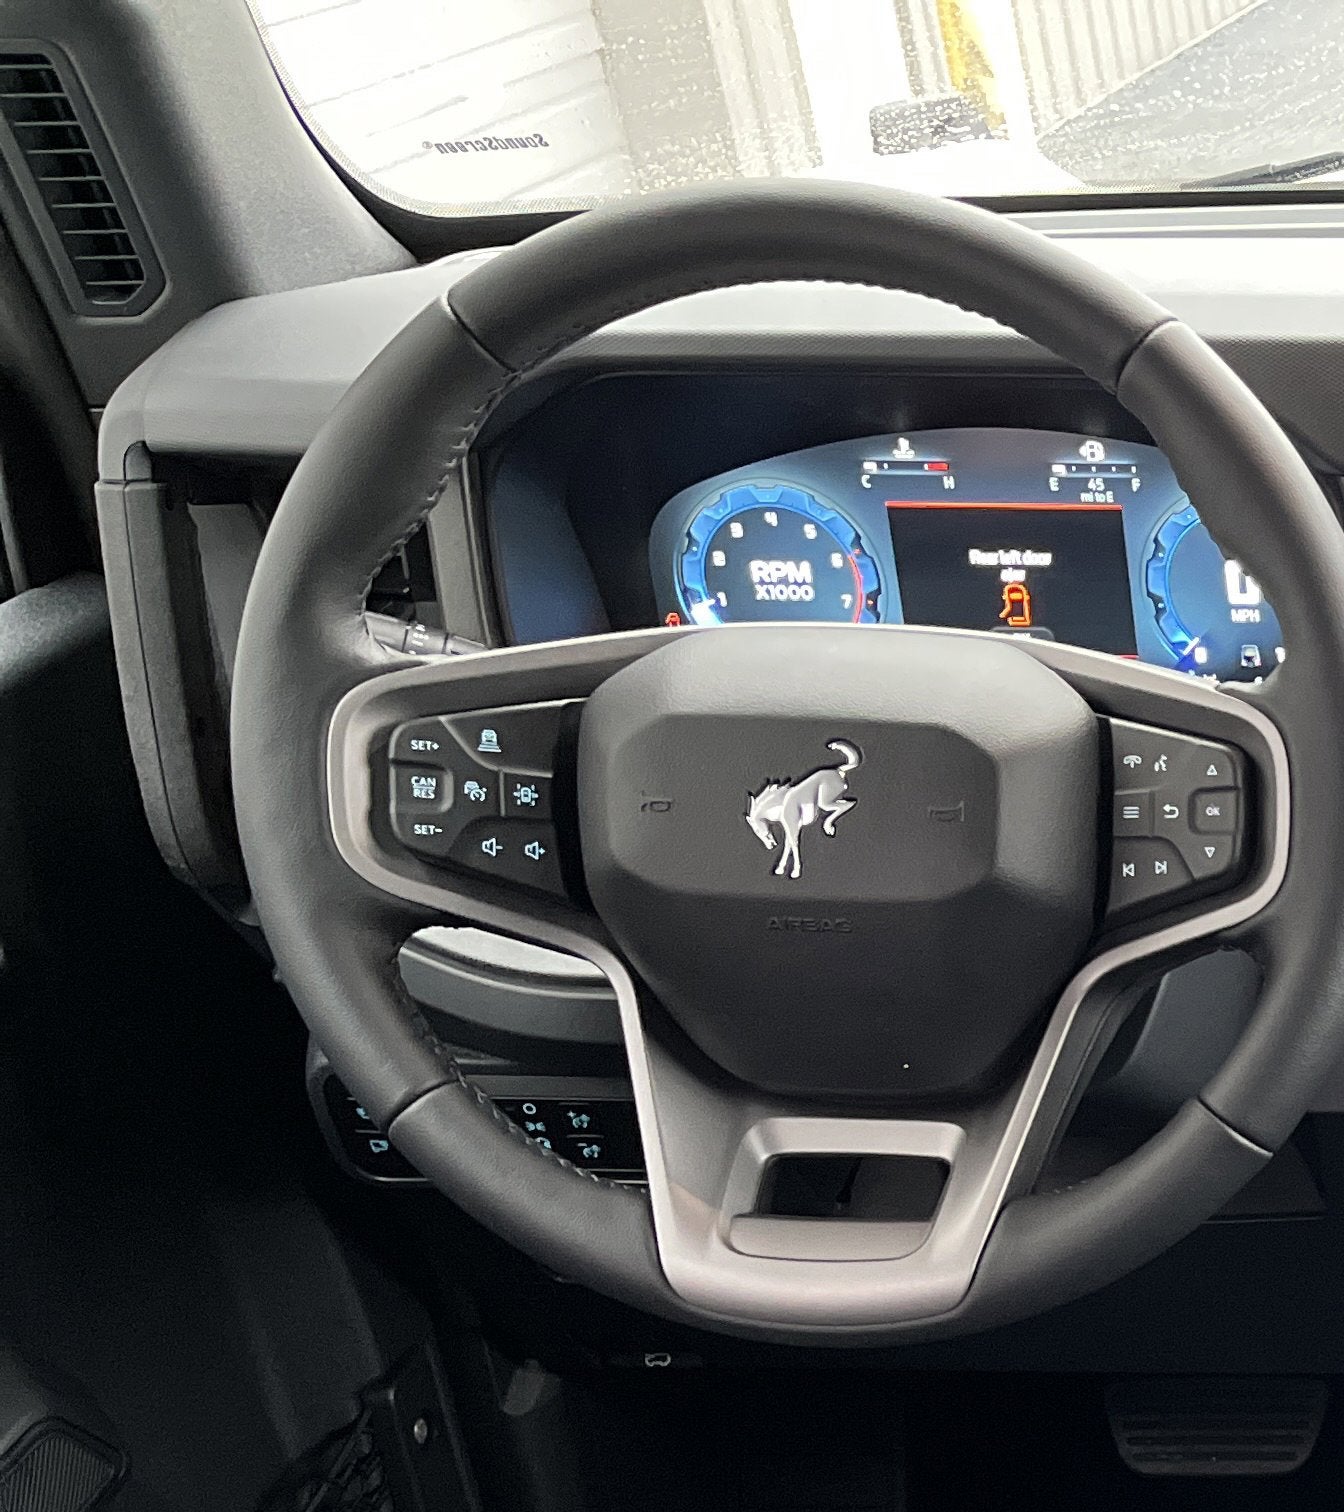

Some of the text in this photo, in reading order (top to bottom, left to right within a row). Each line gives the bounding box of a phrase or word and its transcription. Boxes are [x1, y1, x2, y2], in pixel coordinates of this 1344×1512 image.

[861, 474, 872, 488] C
[943, 476, 955, 489] H
[1049, 476, 1060, 491] E
[1088, 478, 1105, 491] 45
[1131, 476, 1141, 491] F
[764, 512, 778, 526] 4
[804, 524, 817, 539] 5
[750, 560, 812, 583] RPM
[755, 583, 814, 600] X1000
[841, 594, 852, 608] 7
[1230, 608, 1260, 623] MPH
[411, 740, 439, 751] SET+
[411, 776, 436, 787] CAN
[413, 788, 435, 799] RES
